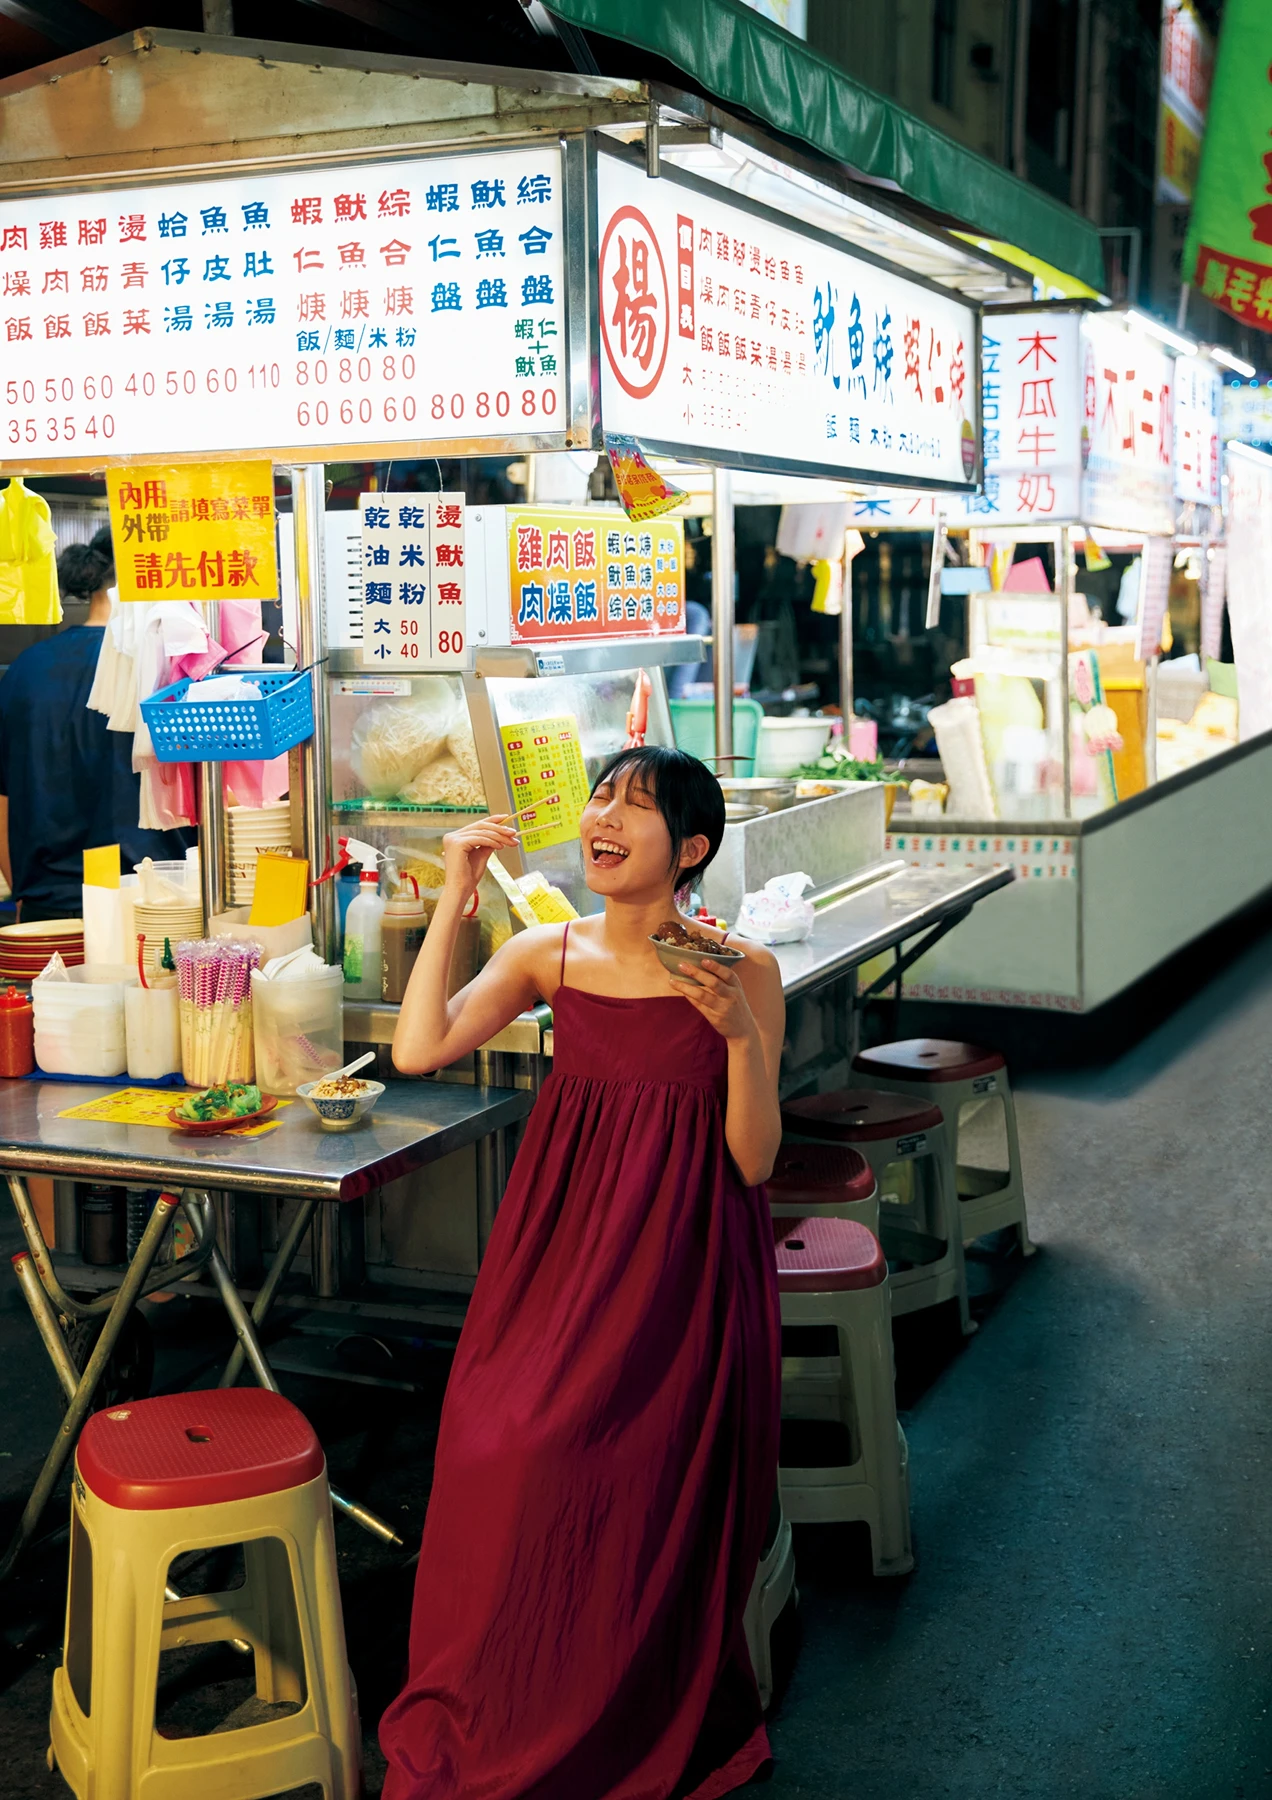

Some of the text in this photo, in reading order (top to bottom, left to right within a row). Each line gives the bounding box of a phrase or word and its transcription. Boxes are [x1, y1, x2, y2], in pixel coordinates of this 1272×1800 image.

[0, 225, 33, 342] 肉燥飯
[39, 221, 72, 339] 雞肉飯
[78, 218, 111, 336] 腳筋飯
[118, 214, 151, 335] 燙青菜
[158, 211, 193, 333] 蛤仔湯
[200, 206, 234, 330] 魚皮湯
[241, 201, 276, 326] 魚肚湯
[425, 183, 463, 313] 蝦仁盤
[470, 179, 508, 310] 魷魚盤
[516, 174, 554, 307] 綜合盤
[514, 319, 558, 339] 蝦仁
[611, 235, 657, 372] 楊
[7, 354, 415, 404] 50 50 60 40 50 60 110 80 80 80
[515, 353, 556, 377] 魷魚
[9, 388, 556, 443] 35 35 40 60 60 60 80 80 80
[1017, 330, 1058, 513] 木瓜牛奶
[119, 480, 167, 510] 內用
[122, 513, 170, 543] 外帶
[170, 495, 271, 523] 請填寫菜單
[134, 550, 259, 589] 請先付款
[364, 506, 392, 605] 乾油麵
[399, 506, 426, 605] 乾米粉
[435, 505, 464, 606] 燙魷魚
[517, 527, 596, 570] 雞肉飯
[373, 618, 418, 635] 大 50
[374, 643, 419, 659] 小 40
[438, 630, 463, 654] 80
[518, 582, 597, 625] 肉燥飯
